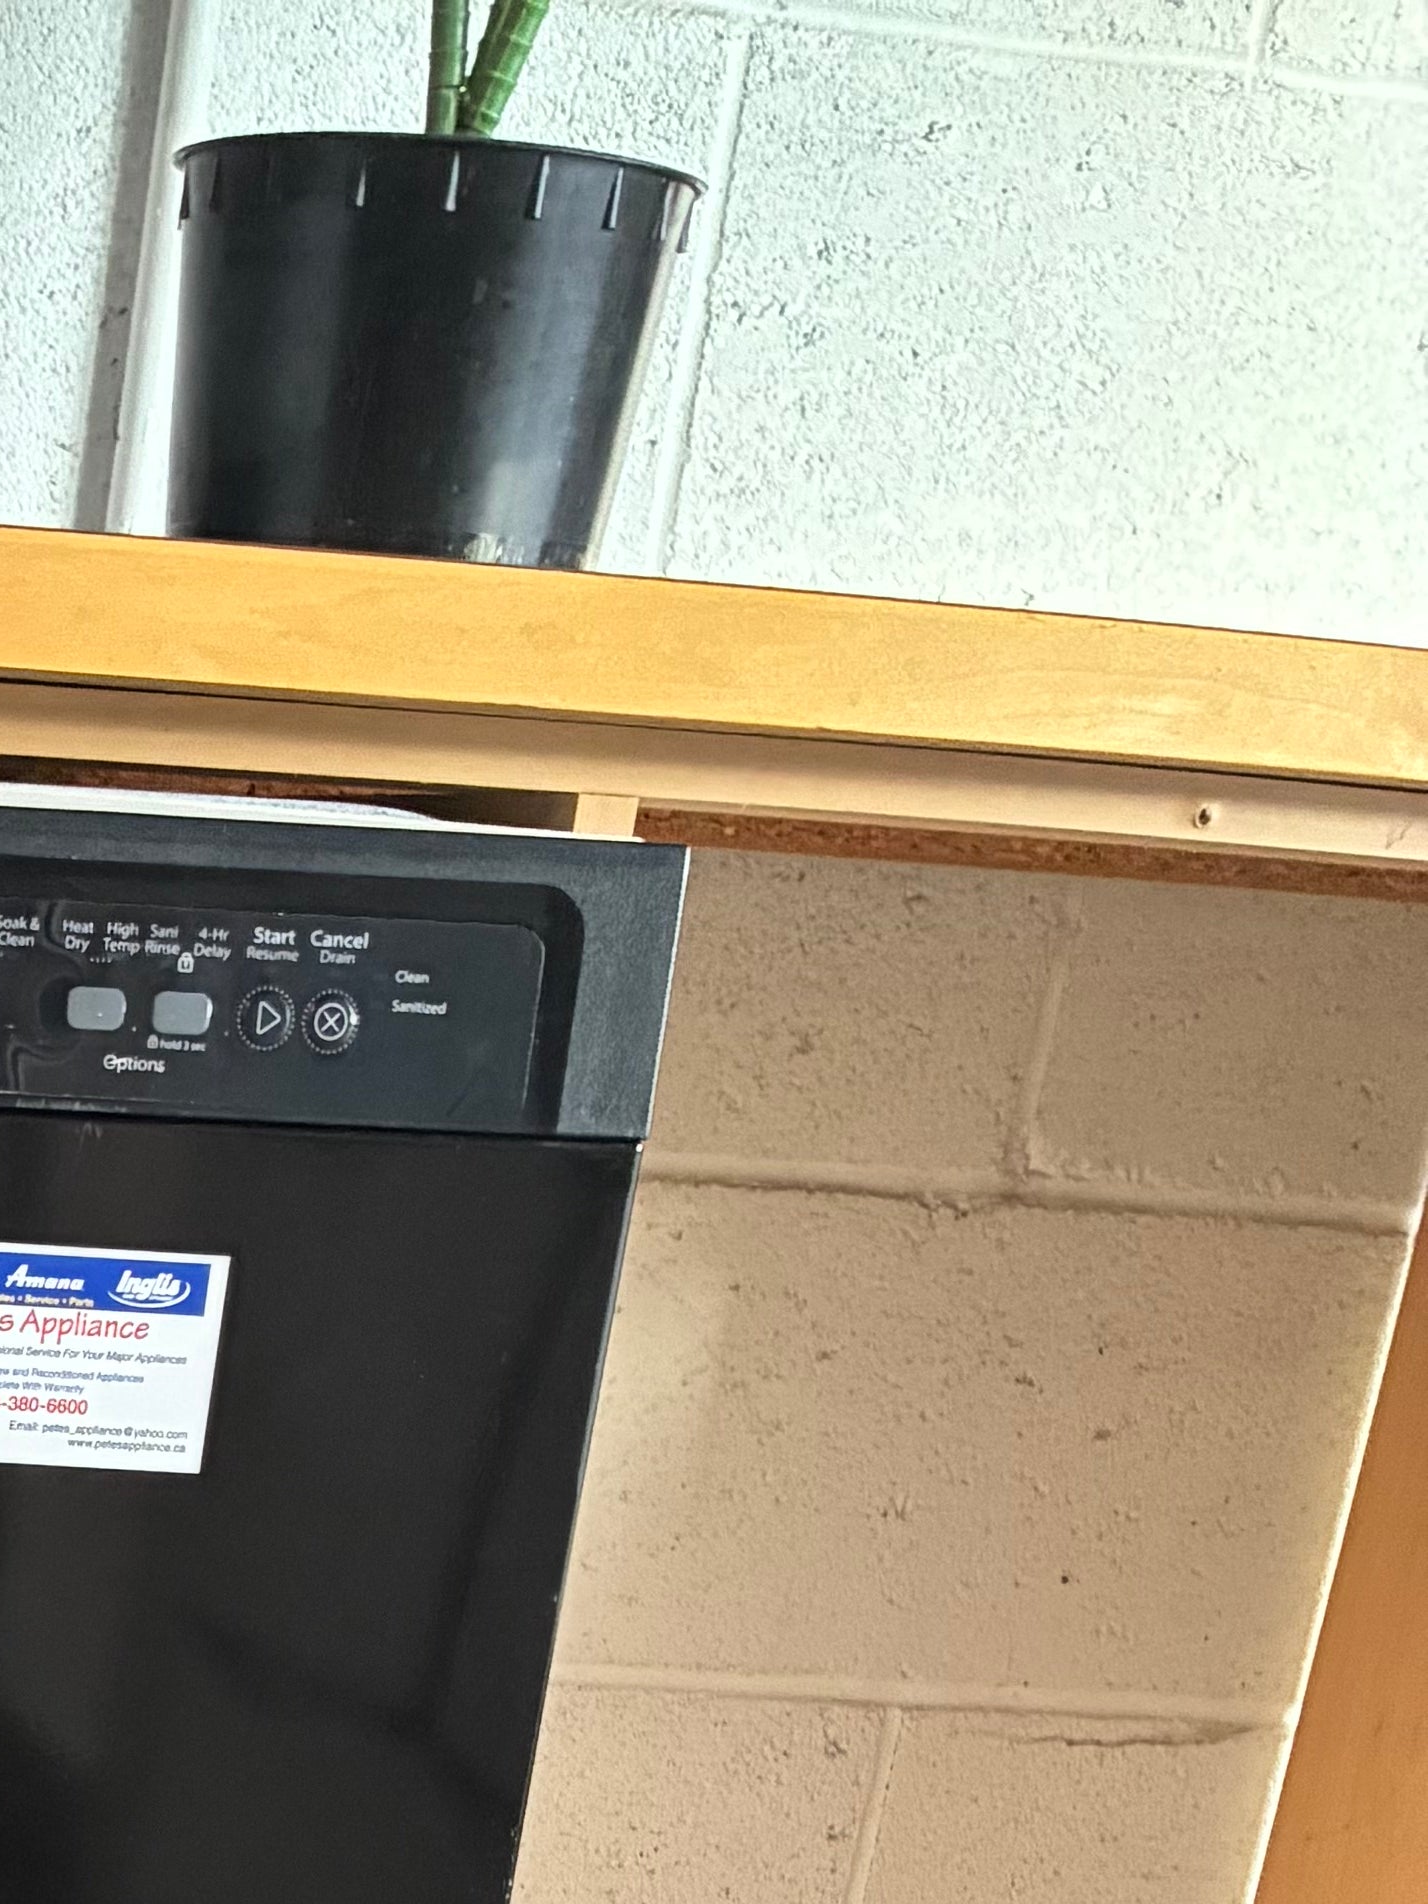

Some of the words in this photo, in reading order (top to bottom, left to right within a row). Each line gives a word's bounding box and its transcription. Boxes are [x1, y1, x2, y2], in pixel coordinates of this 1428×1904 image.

[29, 915, 41, 931] &
[62, 919, 94, 934] Heat
[106, 921, 140, 940] High
[150, 924, 179, 939] Sani
[198, 926, 230, 941] 4-Hr
[253, 926, 296, 945] Start
[310, 929, 370, 949] Cancel
[64, 935, 90, 953] Dry
[103, 937, 140, 955] Temp
[145, 940, 181, 956] Rinse
[194, 943, 231, 961] Delay
[246, 946, 300, 962] Resume
[319, 950, 356, 965] Drain
[394, 970, 430, 984] Clean
[391, 999, 448, 1015] Sanitized
[103, 1054, 166, 1074] Options
[5, 1264, 85, 1291] Amana
[115, 1269, 180, 1300] Inglis
[19, 1309, 151, 1345] Appliance
[26, 1347, 61, 1358] Service
[63, 1349, 80, 1359] For
[83, 1350, 105, 1361] Your
[106, 1351, 134, 1363] Major
[135, 1353, 188, 1366] Appliances
[12, 1367, 30, 1378] and
[31, 1367, 95, 1381] Reconditioned
[96, 1372, 145, 1384] Appliances
[44, 1382, 85, 1395] Warranty
